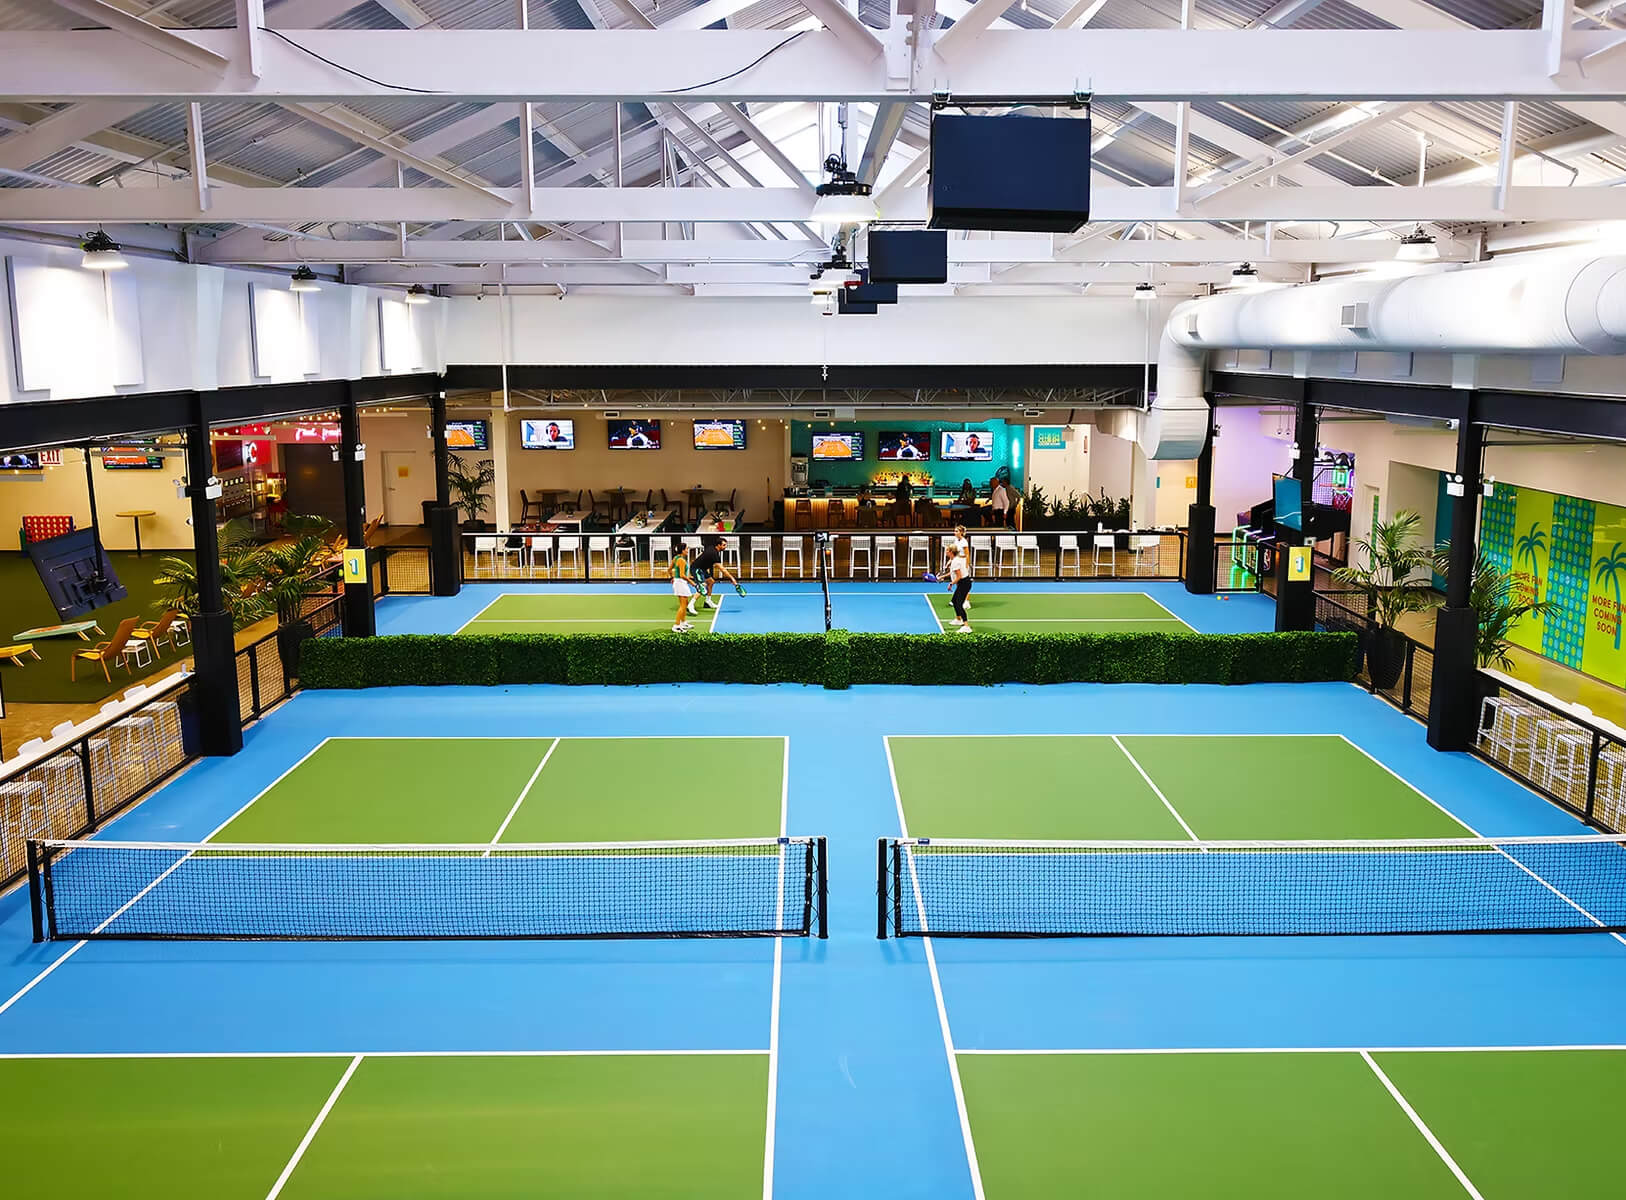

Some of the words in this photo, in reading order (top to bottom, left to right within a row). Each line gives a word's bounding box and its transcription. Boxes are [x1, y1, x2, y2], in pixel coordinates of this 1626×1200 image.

[40, 449, 60, 462] EXIT
[348, 558, 358, 575] 1
[1295, 556, 1304, 573] 1
[1592, 595, 1611, 609] MORE
[1613, 601, 1626, 614] FUN
[1594, 607, 1622, 625] COMING
[1597, 621, 1616, 636] SOON
